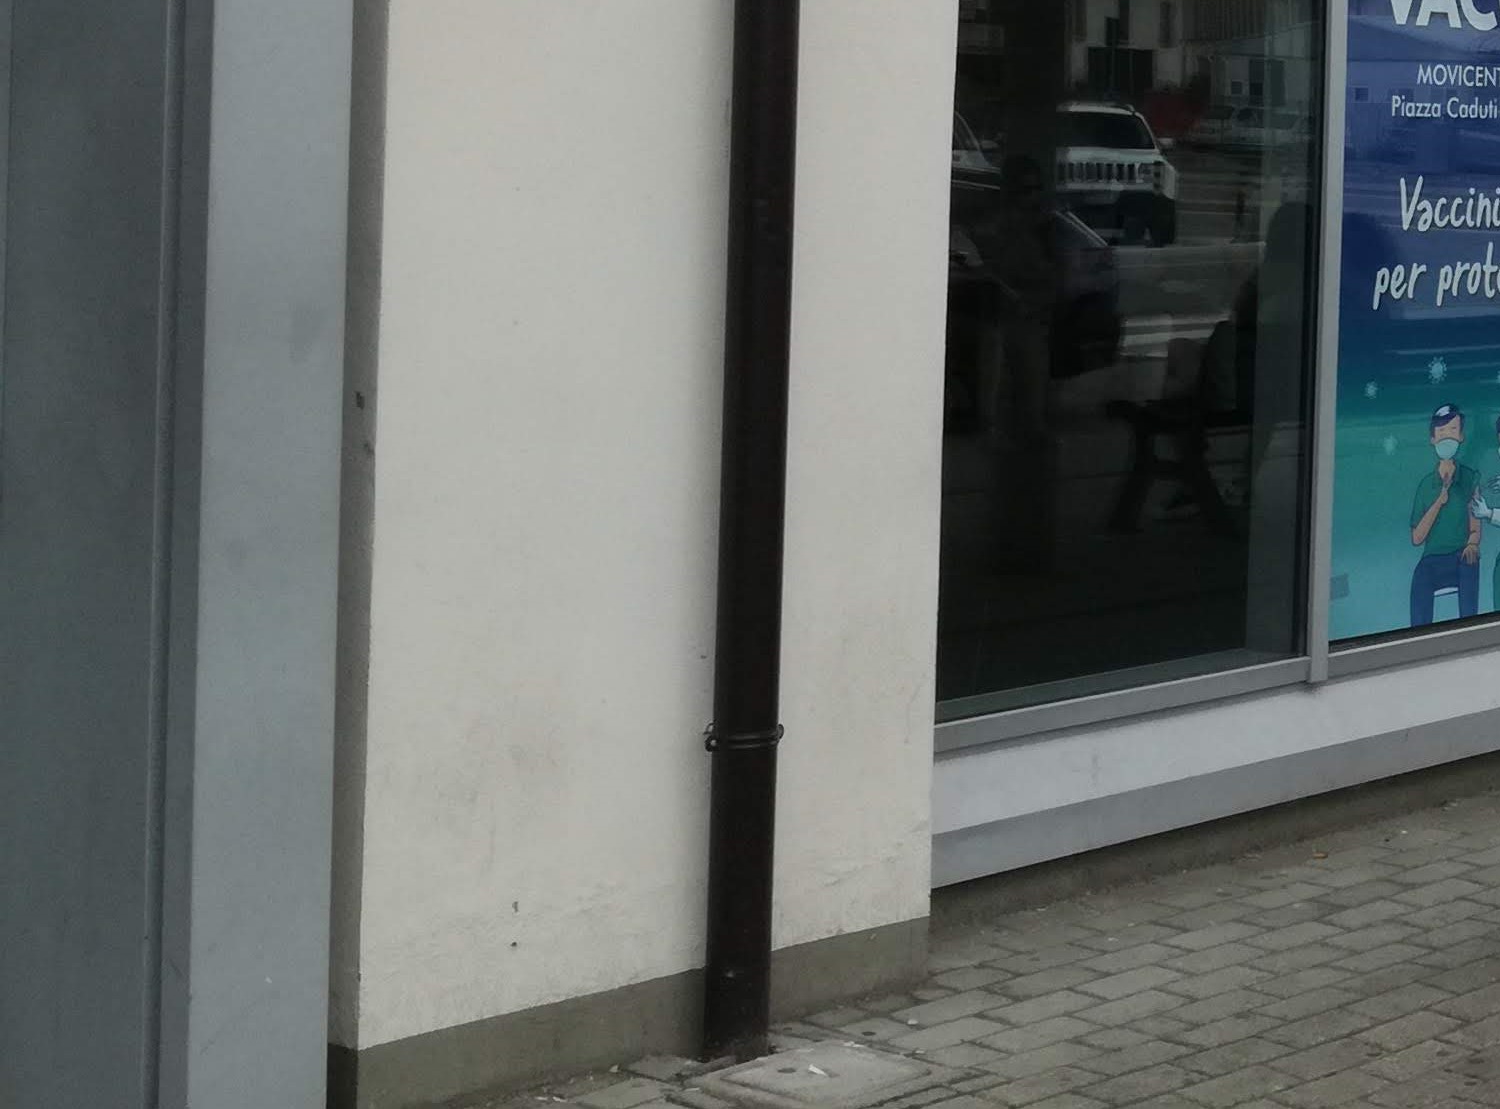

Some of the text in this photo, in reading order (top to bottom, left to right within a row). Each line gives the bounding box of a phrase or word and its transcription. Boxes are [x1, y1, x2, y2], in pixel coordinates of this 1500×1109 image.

[1391, 95, 1441, 119] Piazza
[1446, 97, 1499, 120] Caduti
[1372, 263, 1427, 311] per
